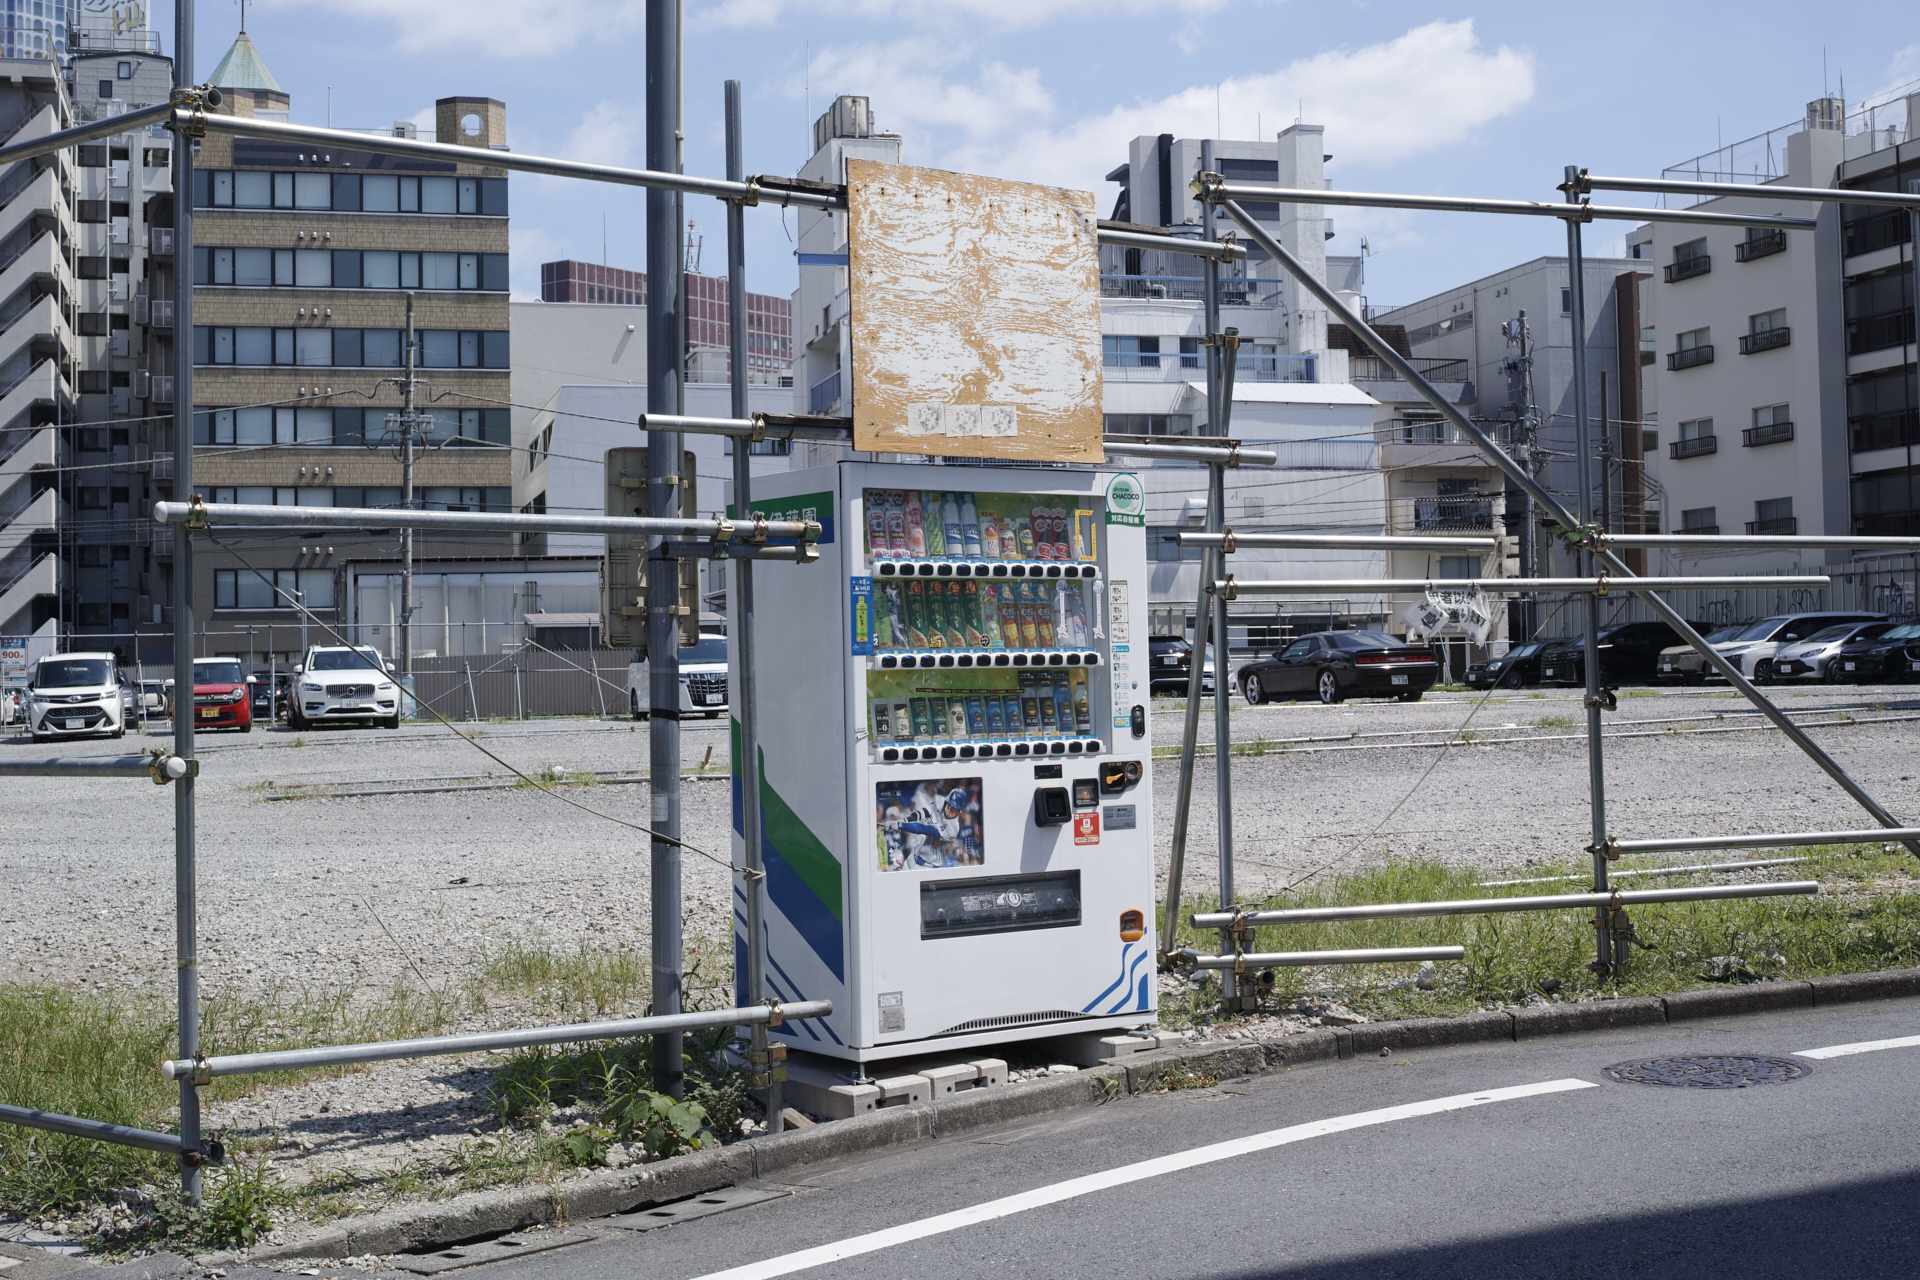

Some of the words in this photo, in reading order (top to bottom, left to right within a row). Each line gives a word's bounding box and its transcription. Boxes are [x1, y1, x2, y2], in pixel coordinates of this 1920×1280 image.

[1111, 514, 1140, 524] 対応自販機
